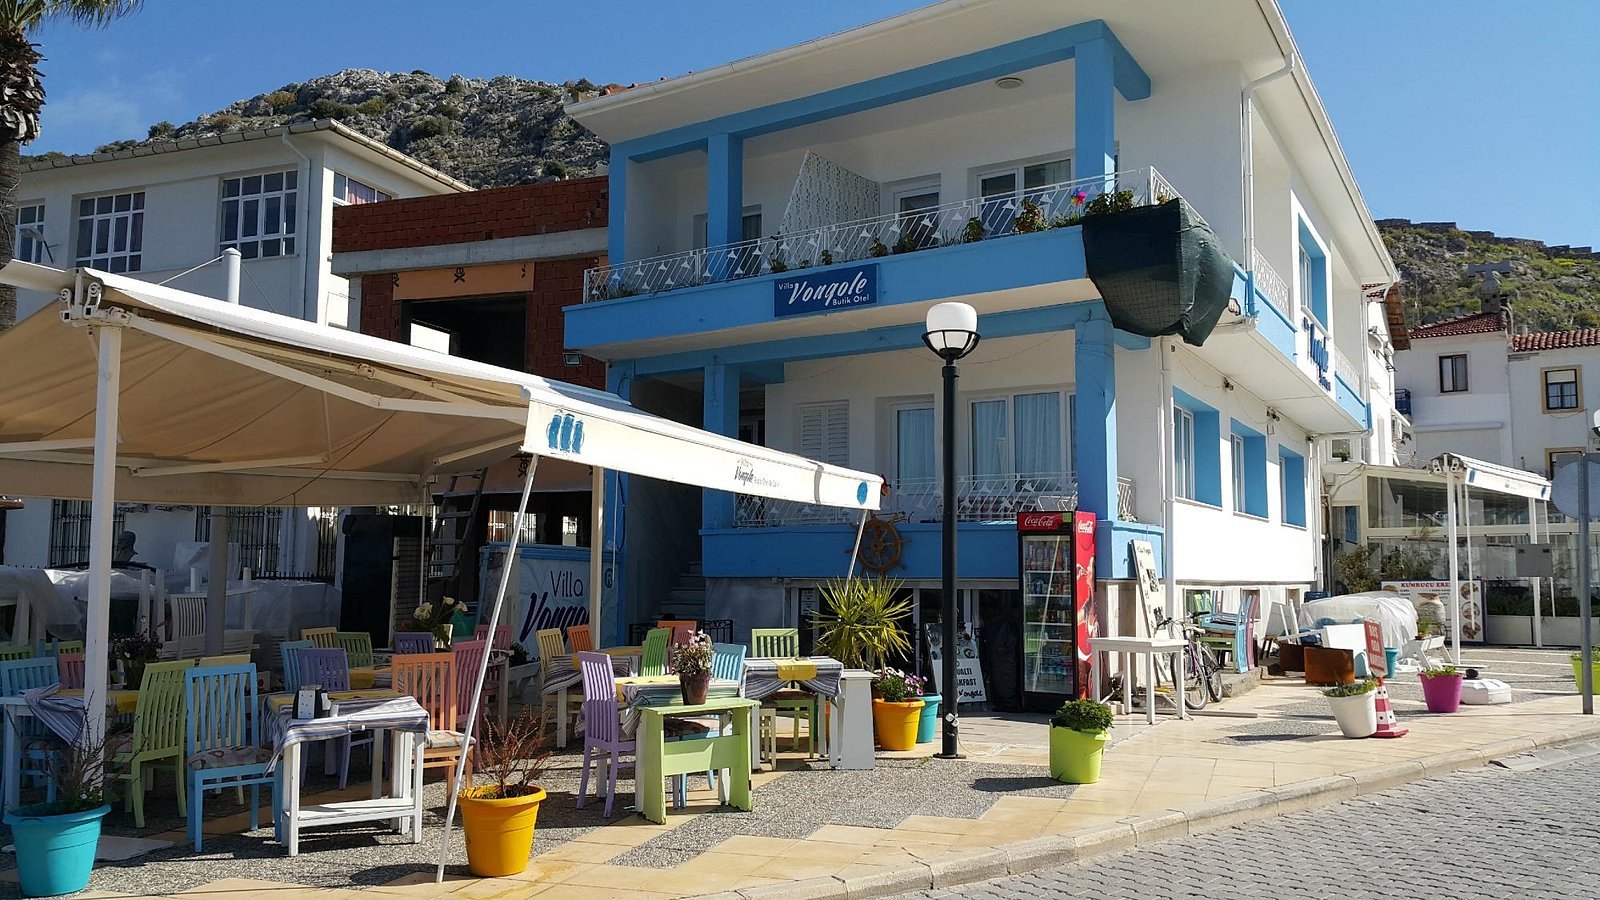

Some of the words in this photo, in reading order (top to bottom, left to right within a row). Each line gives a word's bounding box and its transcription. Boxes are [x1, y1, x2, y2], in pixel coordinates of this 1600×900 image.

[778, 281, 794, 291] Villa
[788, 271, 868, 306] Vongole
[832, 298, 852, 306] Butik
[853, 294, 870, 303] Otel
[550, 570, 584, 597] Villa
[519, 592, 590, 645] Vongo
